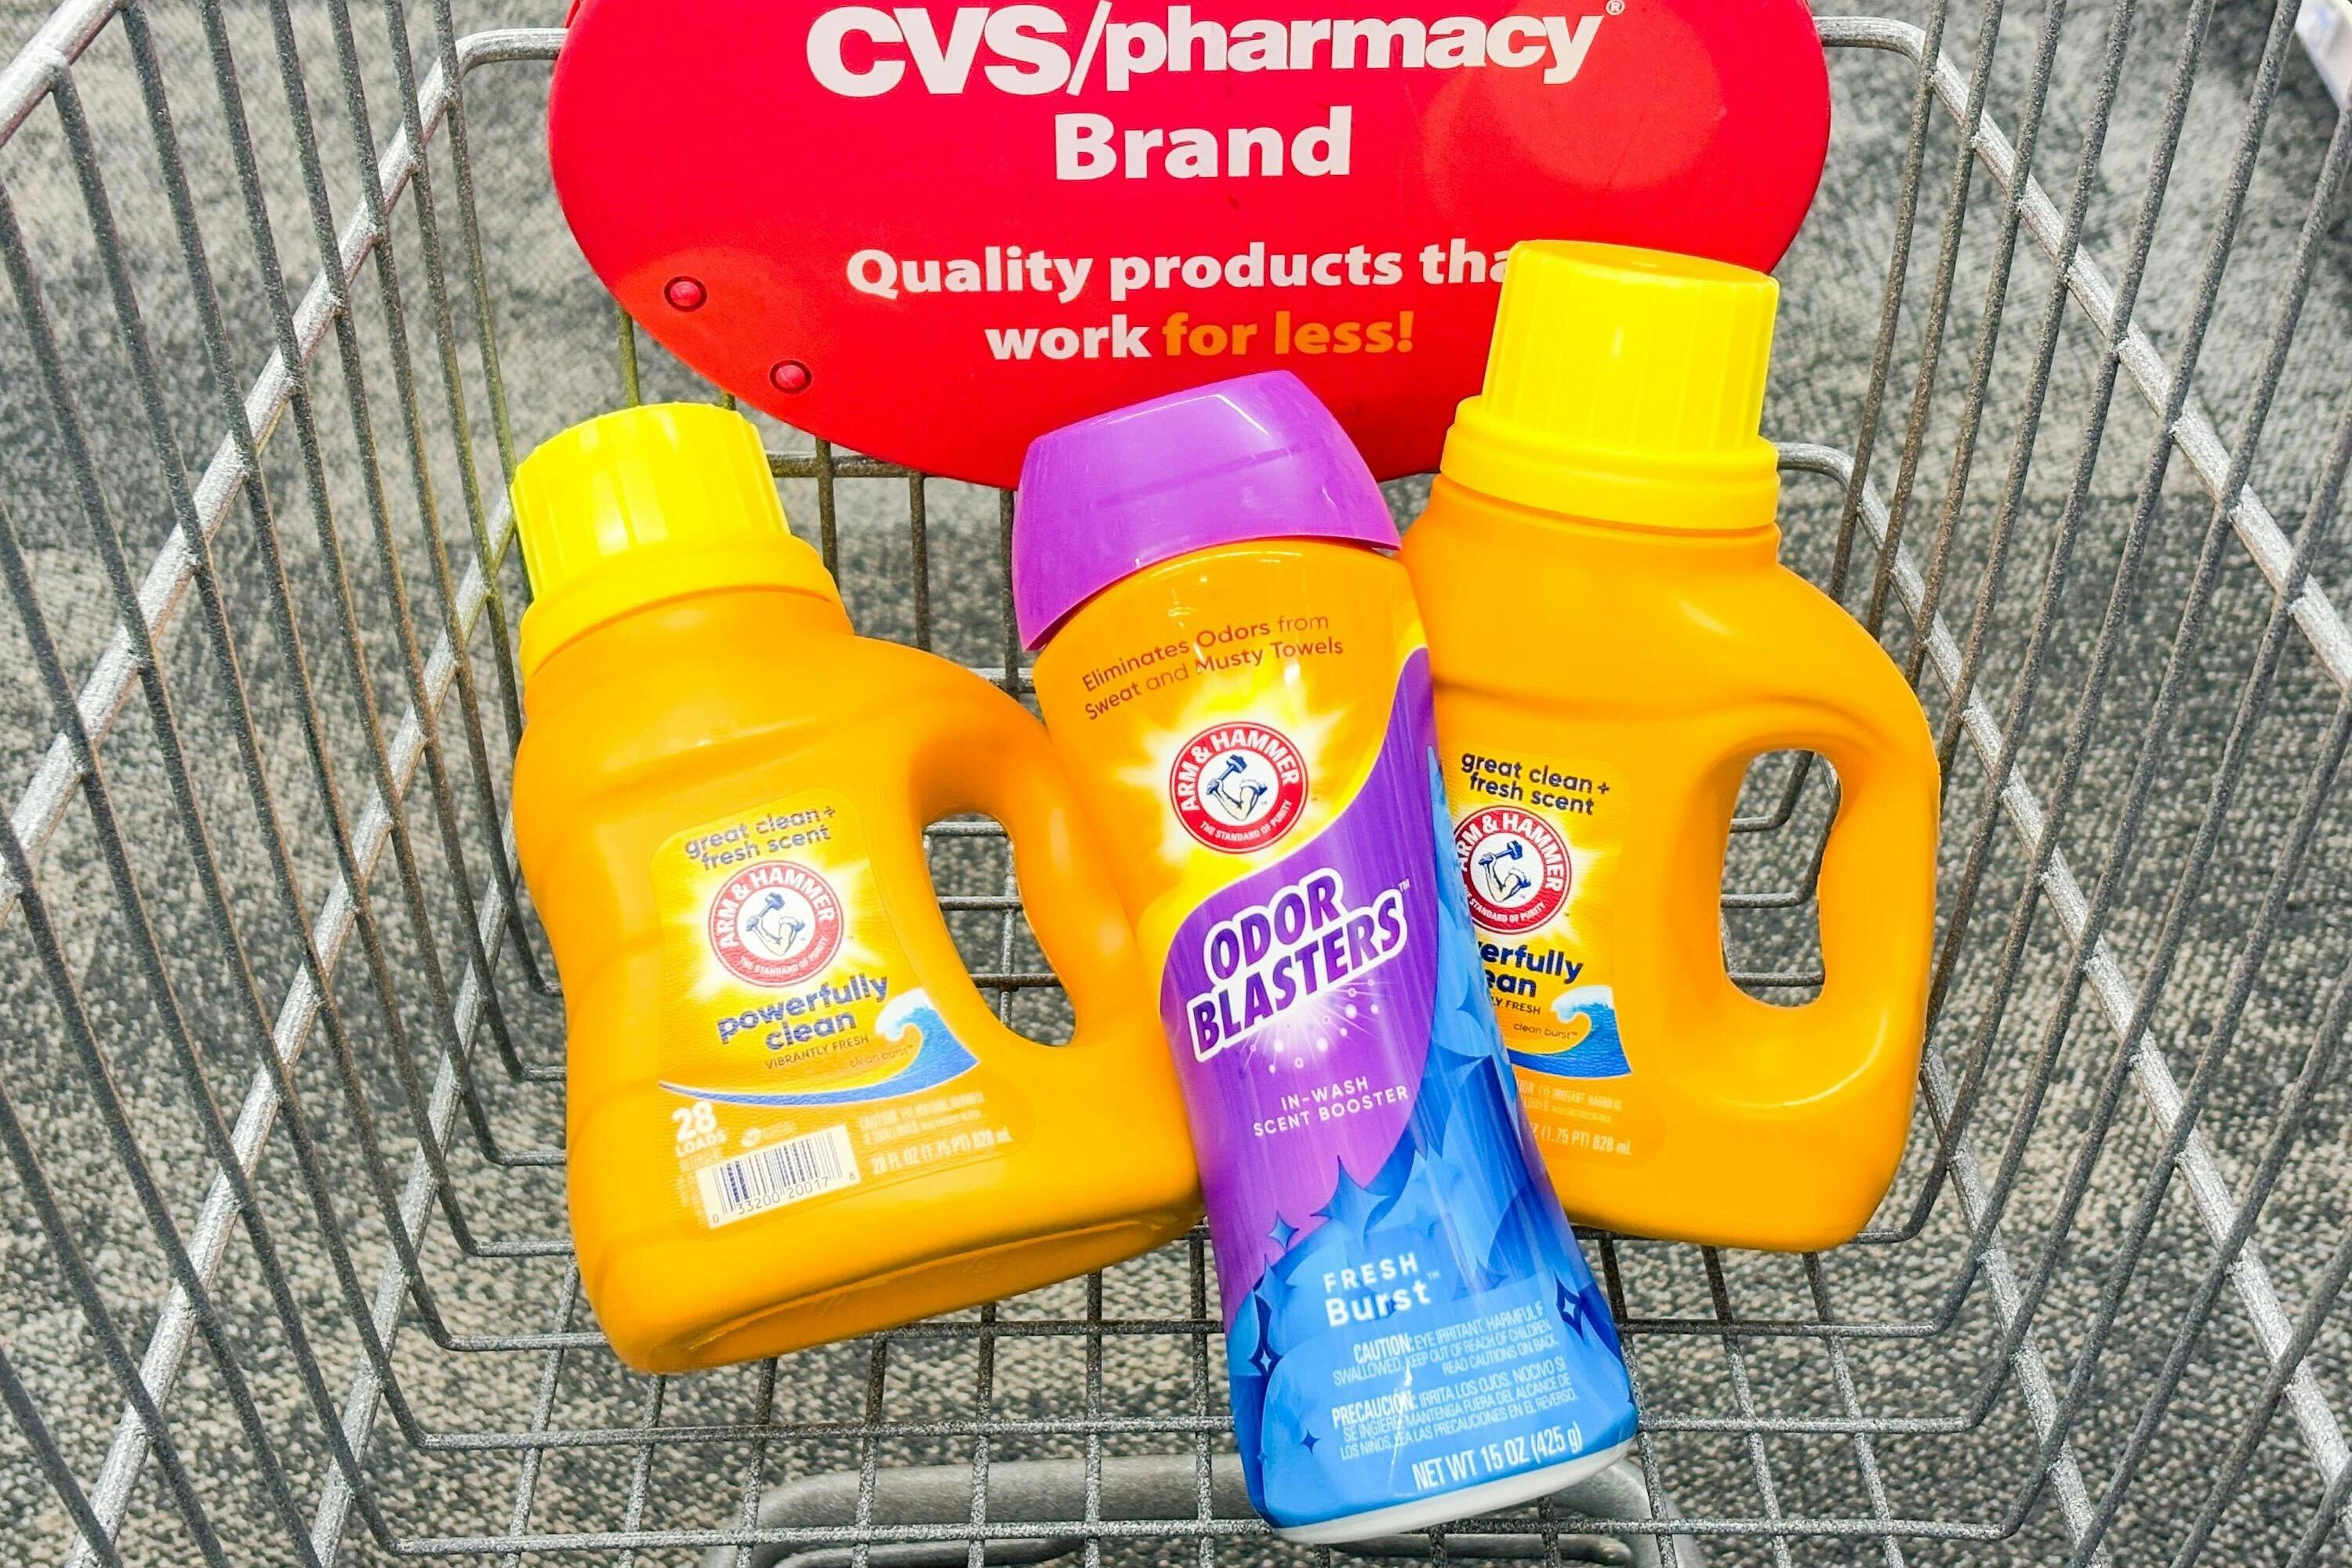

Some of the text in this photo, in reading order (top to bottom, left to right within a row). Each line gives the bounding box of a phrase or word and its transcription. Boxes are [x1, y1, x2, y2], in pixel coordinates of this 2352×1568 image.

[1054, 105, 1352, 180] Brand
[846, 238, 1510, 303] Quality products tha
[984, 310, 1414, 360] work for less!
[1082, 615, 1329, 691] Eliminates Odors from
[1085, 637, 1343, 720] Sweat and Musty Towels
[1178, 728, 1300, 811] ARM & HAMMER
[1461, 753, 1523, 779] great
[1469, 771, 1594, 815] fresh scent
[685, 824, 750, 859] great
[1200, 799, 1292, 841] THE STANDARD OF PURITY
[701, 825, 831, 870] fresh scent
[1482, 815, 1500, 833] &
[1502, 812, 1564, 892] HAMMER
[717, 867, 836, 949] ARM & HAMMER
[1207, 871, 1345, 982] ODOR
[1469, 898, 1508, 923] STANDARD
[1508, 913, 1519, 924] OF
[1478, 941, 1584, 985] erfully
[717, 973, 887, 1044] powerfully
[1505, 1000, 1541, 1014] FRESH
[1514, 1022, 1542, 1034] clean
[764, 1034, 869, 1069] VIBRANTLY FRESH
[765, 1011, 857, 1050] clean
[1253, 1085, 1408, 1137] SCENT BOOSTER
[1281, 1076, 1369, 1111] IN-WASH
[672, 1101, 717, 1142] 28
[676, 1127, 728, 1157] LOADS
[712, 1214, 720, 1224] 0
[736, 1191, 780, 1215] 33200
[786, 1176, 829, 1199] 20017
[1323, 1251, 1418, 1293] FRESH
[1353, 1332, 1414, 1364] CAUTION:
[1414, 1331, 1436, 1351] EYE
[1485, 1305, 1537, 1330] HARMFUL
[1534, 1300, 1544, 1318] IF
[1405, 1351, 1428, 1368] KEEP
[1429, 1345, 1450, 1363] OUT
[1450, 1341, 1464, 1358] OF
[1463, 1334, 1496, 1354] REACH
[1494, 1331, 1510, 1345] OF
[1442, 1357, 1468, 1376] READ
[1468, 1345, 1518, 1369] CAUTIONS
[1517, 1340, 1534, 1356] ON
[1417, 1385, 1456, 1408] IRRITA
[1455, 1378, 1479, 1399] LOS
[1512, 1359, 1555, 1384] NOCIVO
[1554, 1355, 1566, 1372] SI
[1340, 1443, 1360, 1461] LOS
[1414, 1425, 1434, 1443] LAS
[1433, 1406, 1509, 1436] PRECAUCIONES
[1507, 1402, 1526, 1418] EN
[1523, 1399, 1537, 1414] EL
[1342, 1425, 1359, 1443] SE
[1403, 1402, 1464, 1428] MANTENGA
[1462, 1393, 1497, 1414] FUERA
[1496, 1388, 1515, 1406] DEL
[1515, 1375, 1558, 1400] ALCANCE
[1557, 1371, 1572, 1388] DE
[1412, 1421, 1583, 1490] NET WT 15 OZ (425 g)
